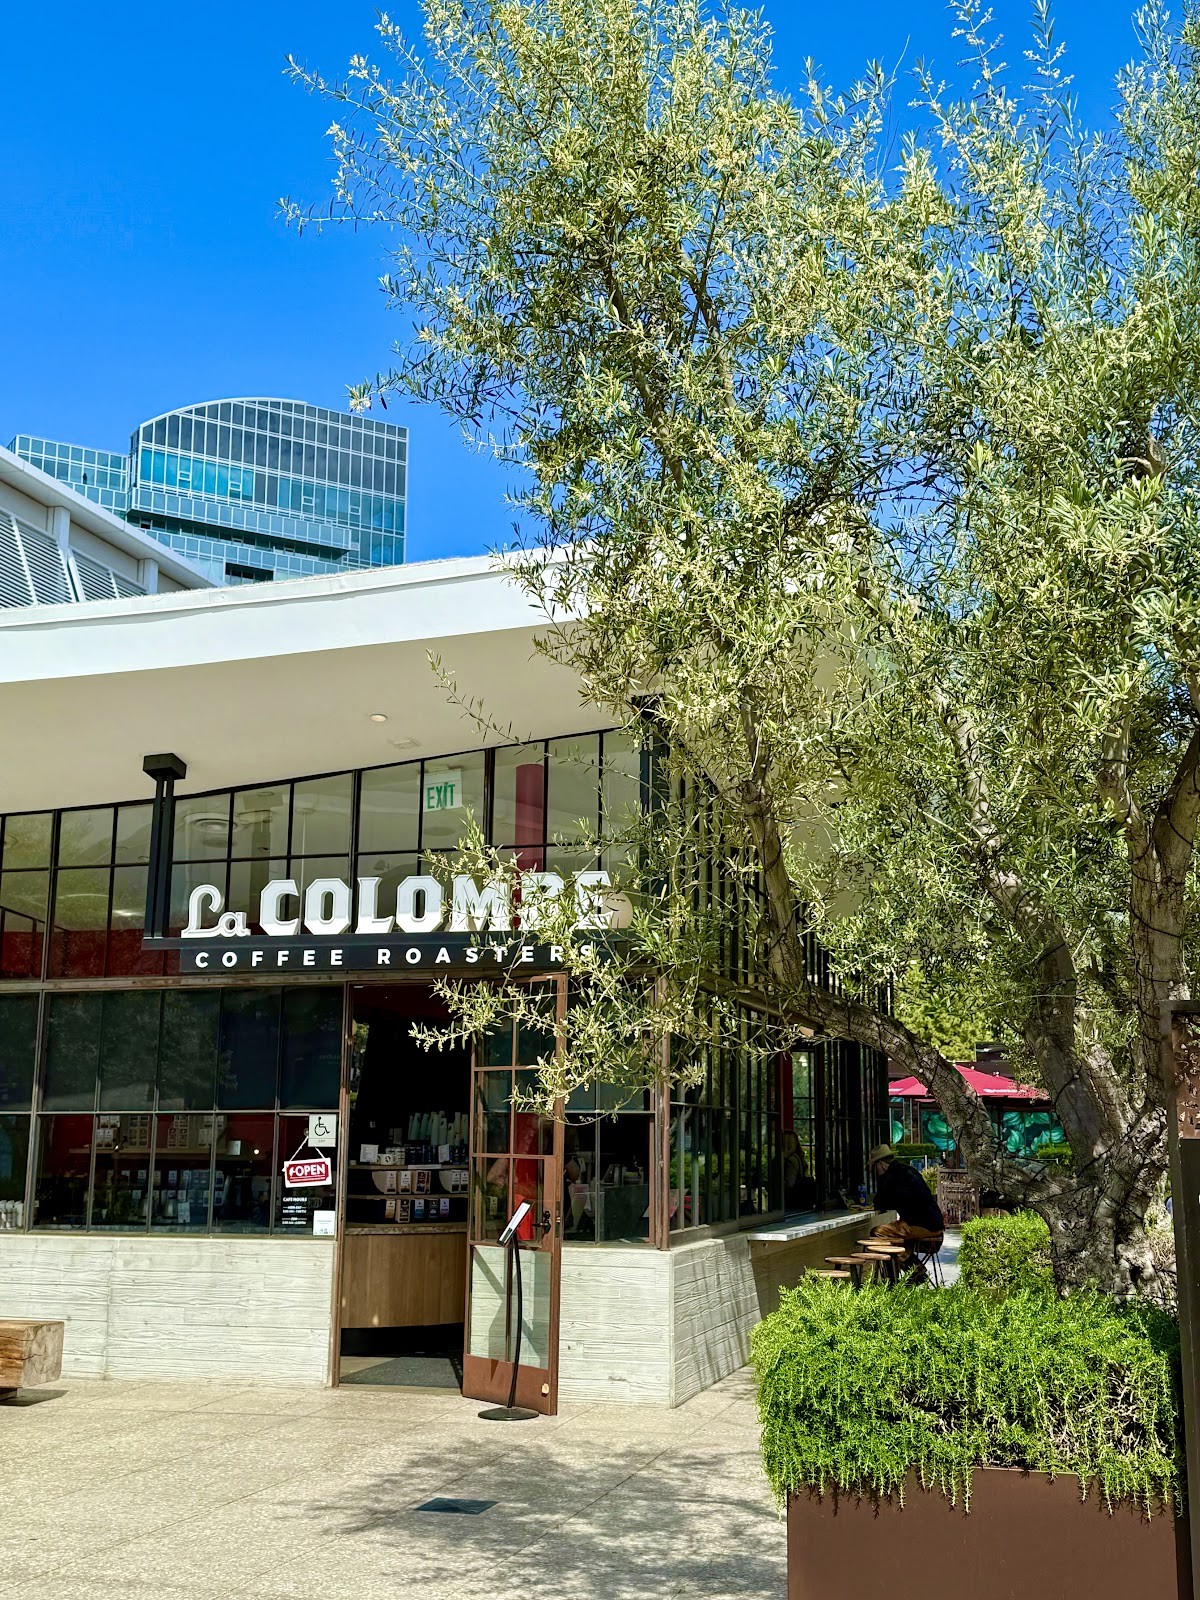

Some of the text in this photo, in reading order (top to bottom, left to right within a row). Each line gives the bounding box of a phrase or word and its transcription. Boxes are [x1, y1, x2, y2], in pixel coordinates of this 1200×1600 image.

[426, 783, 456, 810] EXIT
[180, 884, 252, 938] La
[195, 948, 344, 968] COFFEE
[295, 1163, 326, 1177] OPEN
